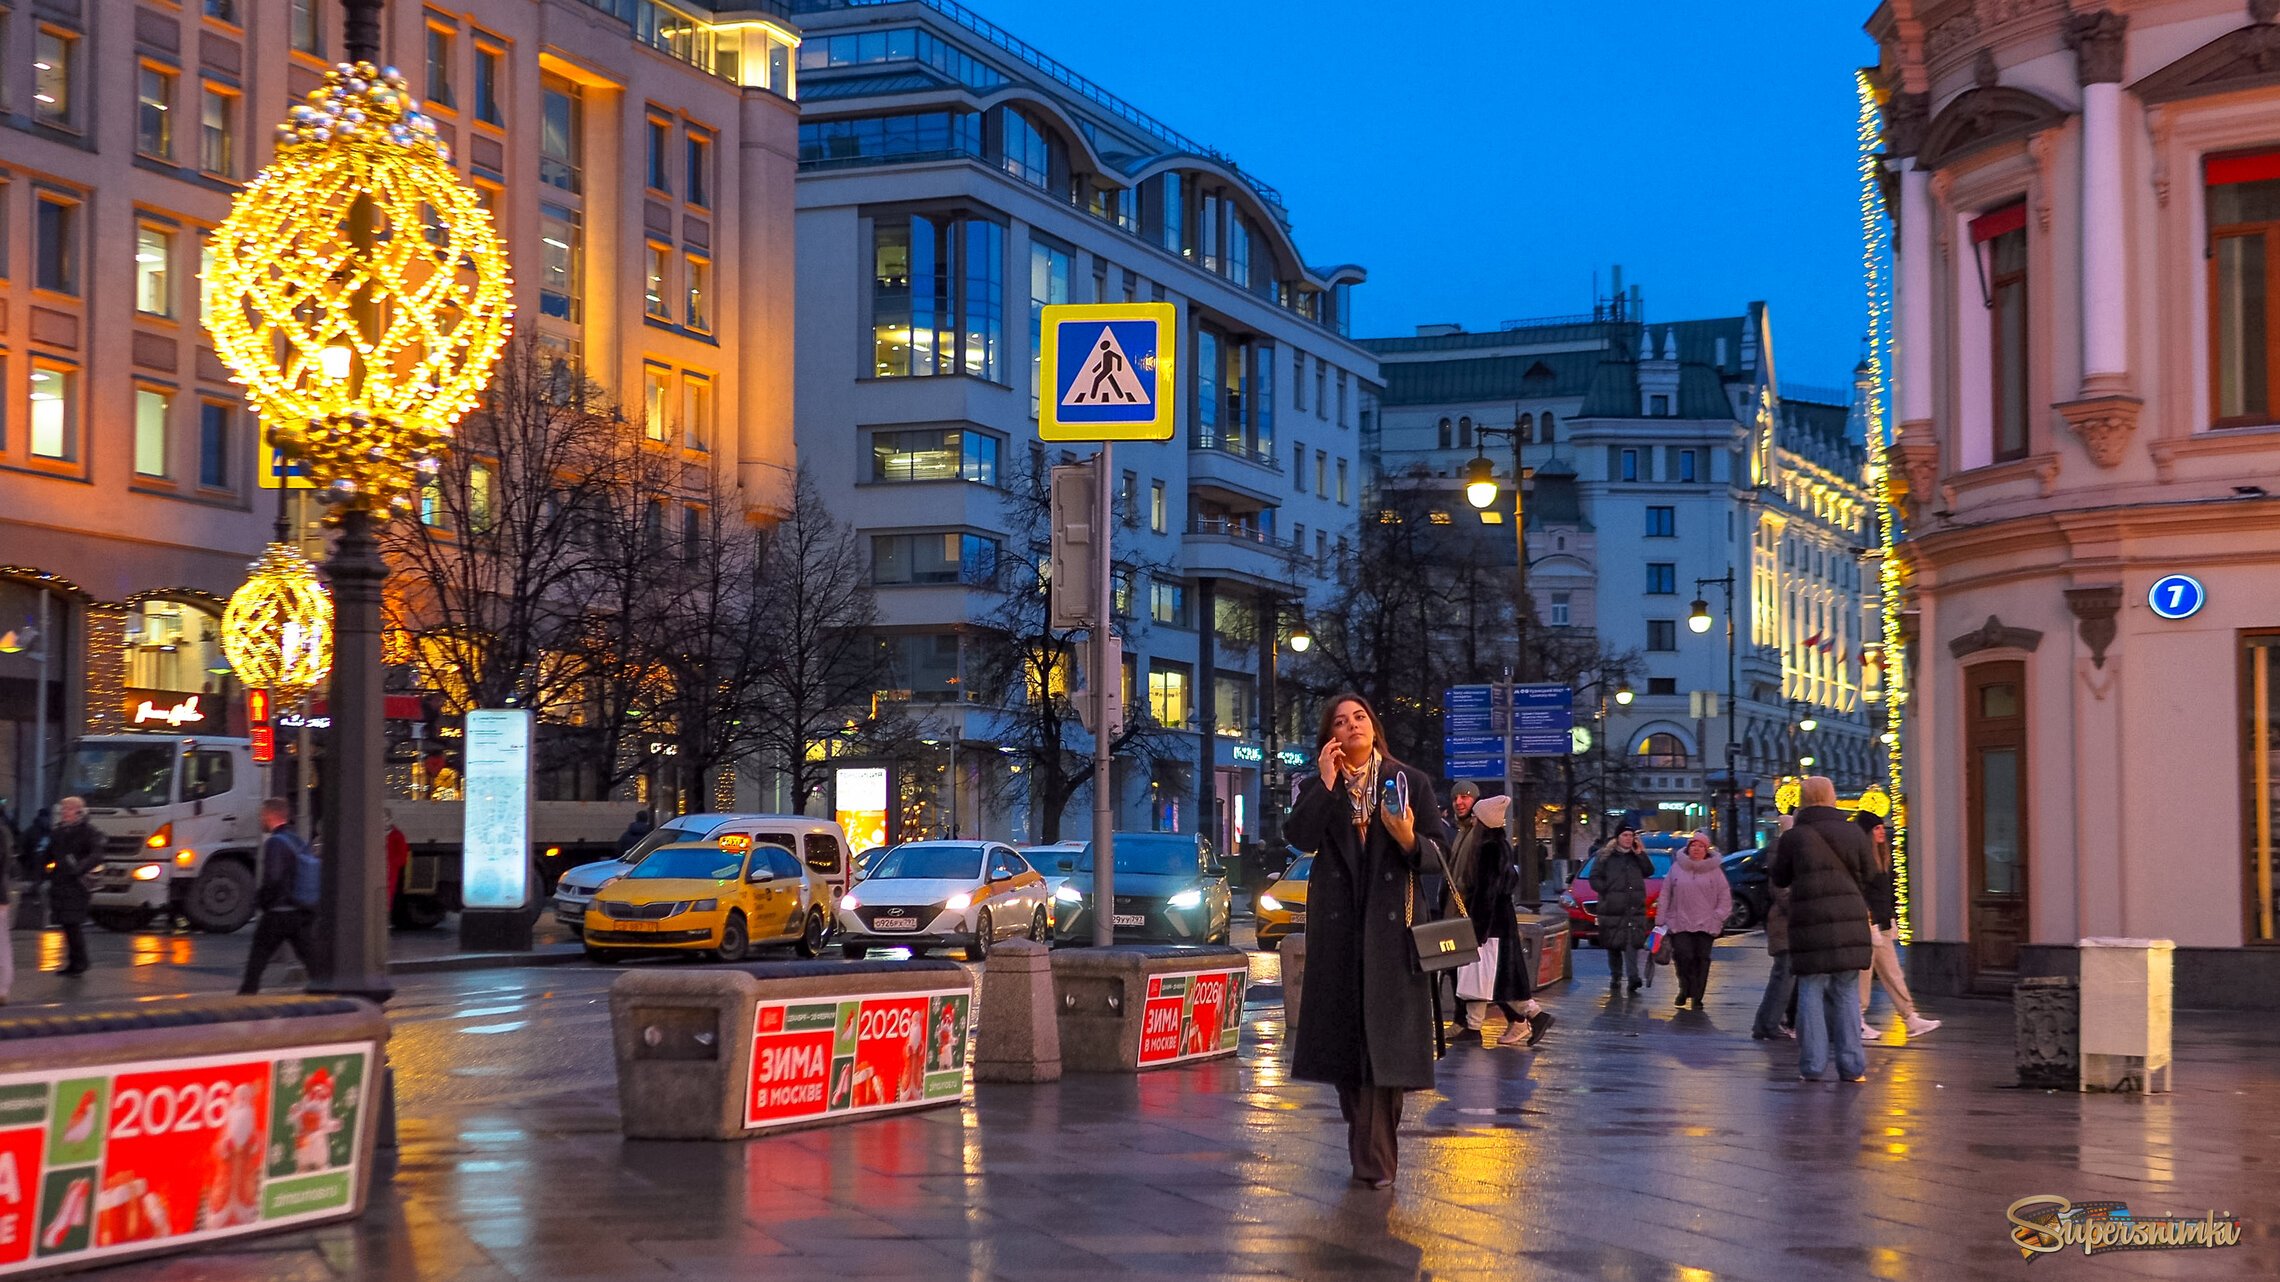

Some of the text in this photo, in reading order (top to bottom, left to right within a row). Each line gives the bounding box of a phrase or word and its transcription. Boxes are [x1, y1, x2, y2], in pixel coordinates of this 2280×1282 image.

[2167, 585, 2184, 609] 7
[1194, 981, 1219, 1005] 2026
[859, 1008, 911, 1041] 2026
[1146, 1007, 1178, 1034] ЗИМА
[1144, 1035, 1177, 1052] В МОСКВЕ
[759, 1044, 825, 1083] ЗИМА
[757, 1082, 823, 1108] В МОСКВЕ
[111, 1080, 232, 1139] 2026
